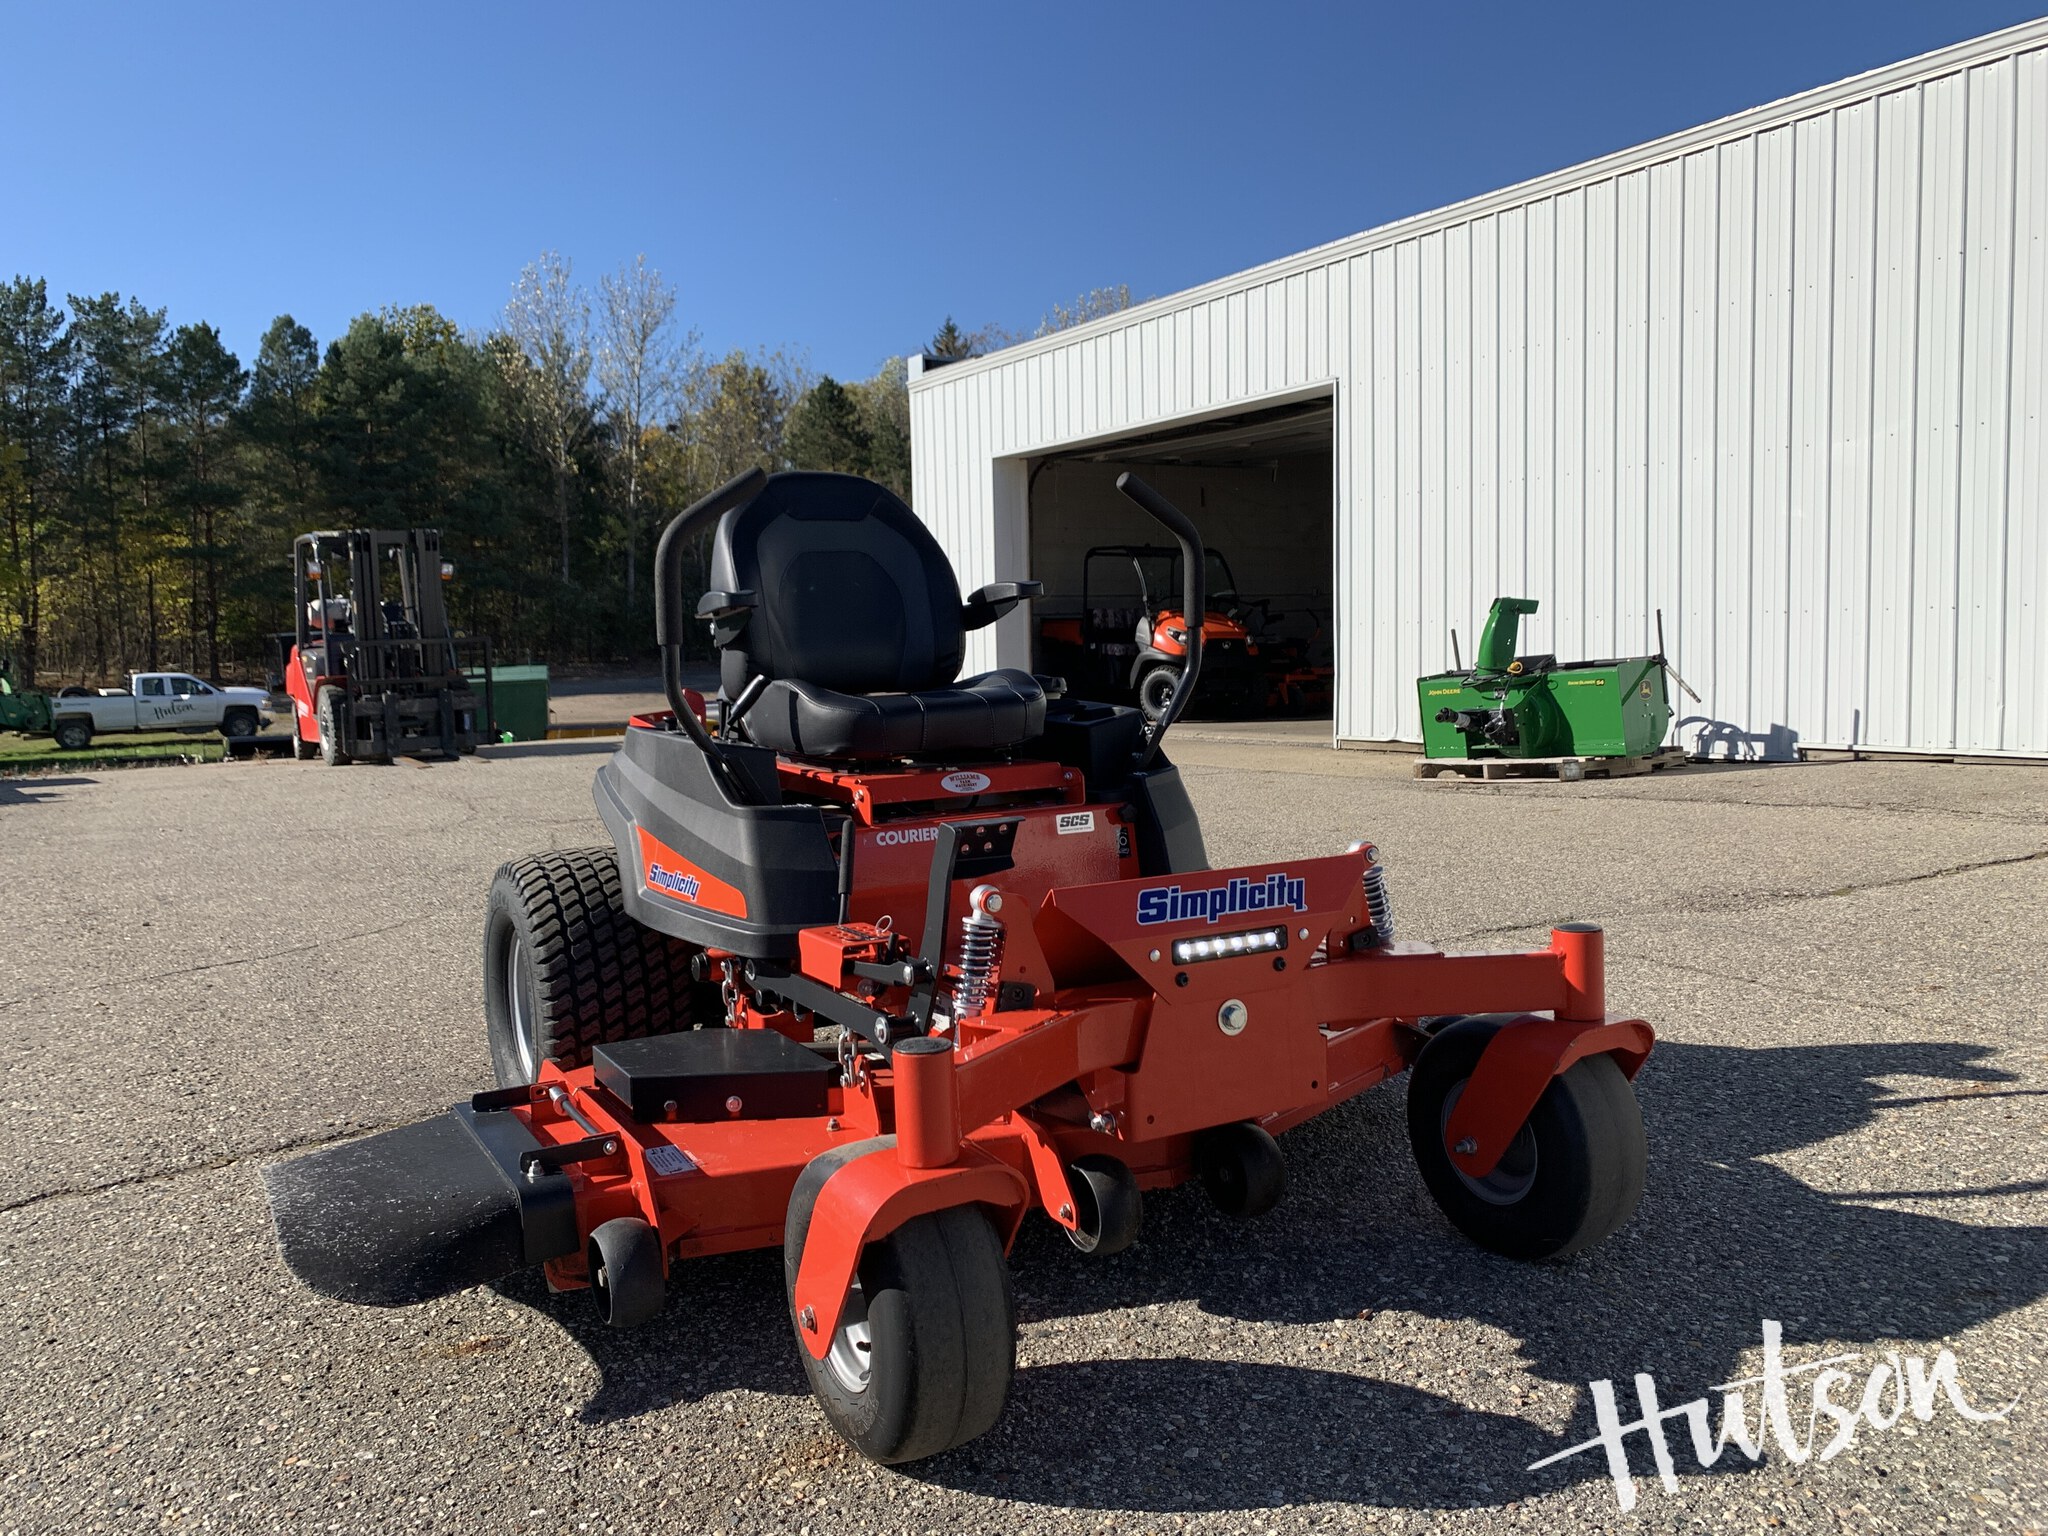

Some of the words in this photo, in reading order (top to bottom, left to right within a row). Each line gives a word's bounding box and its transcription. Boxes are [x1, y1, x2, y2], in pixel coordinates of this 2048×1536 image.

[1060, 814, 1090, 828] SCS
[876, 827, 939, 846] COURIER
[648, 862, 701, 902] Simplicity
[1136, 873, 1308, 926] Simplicity
